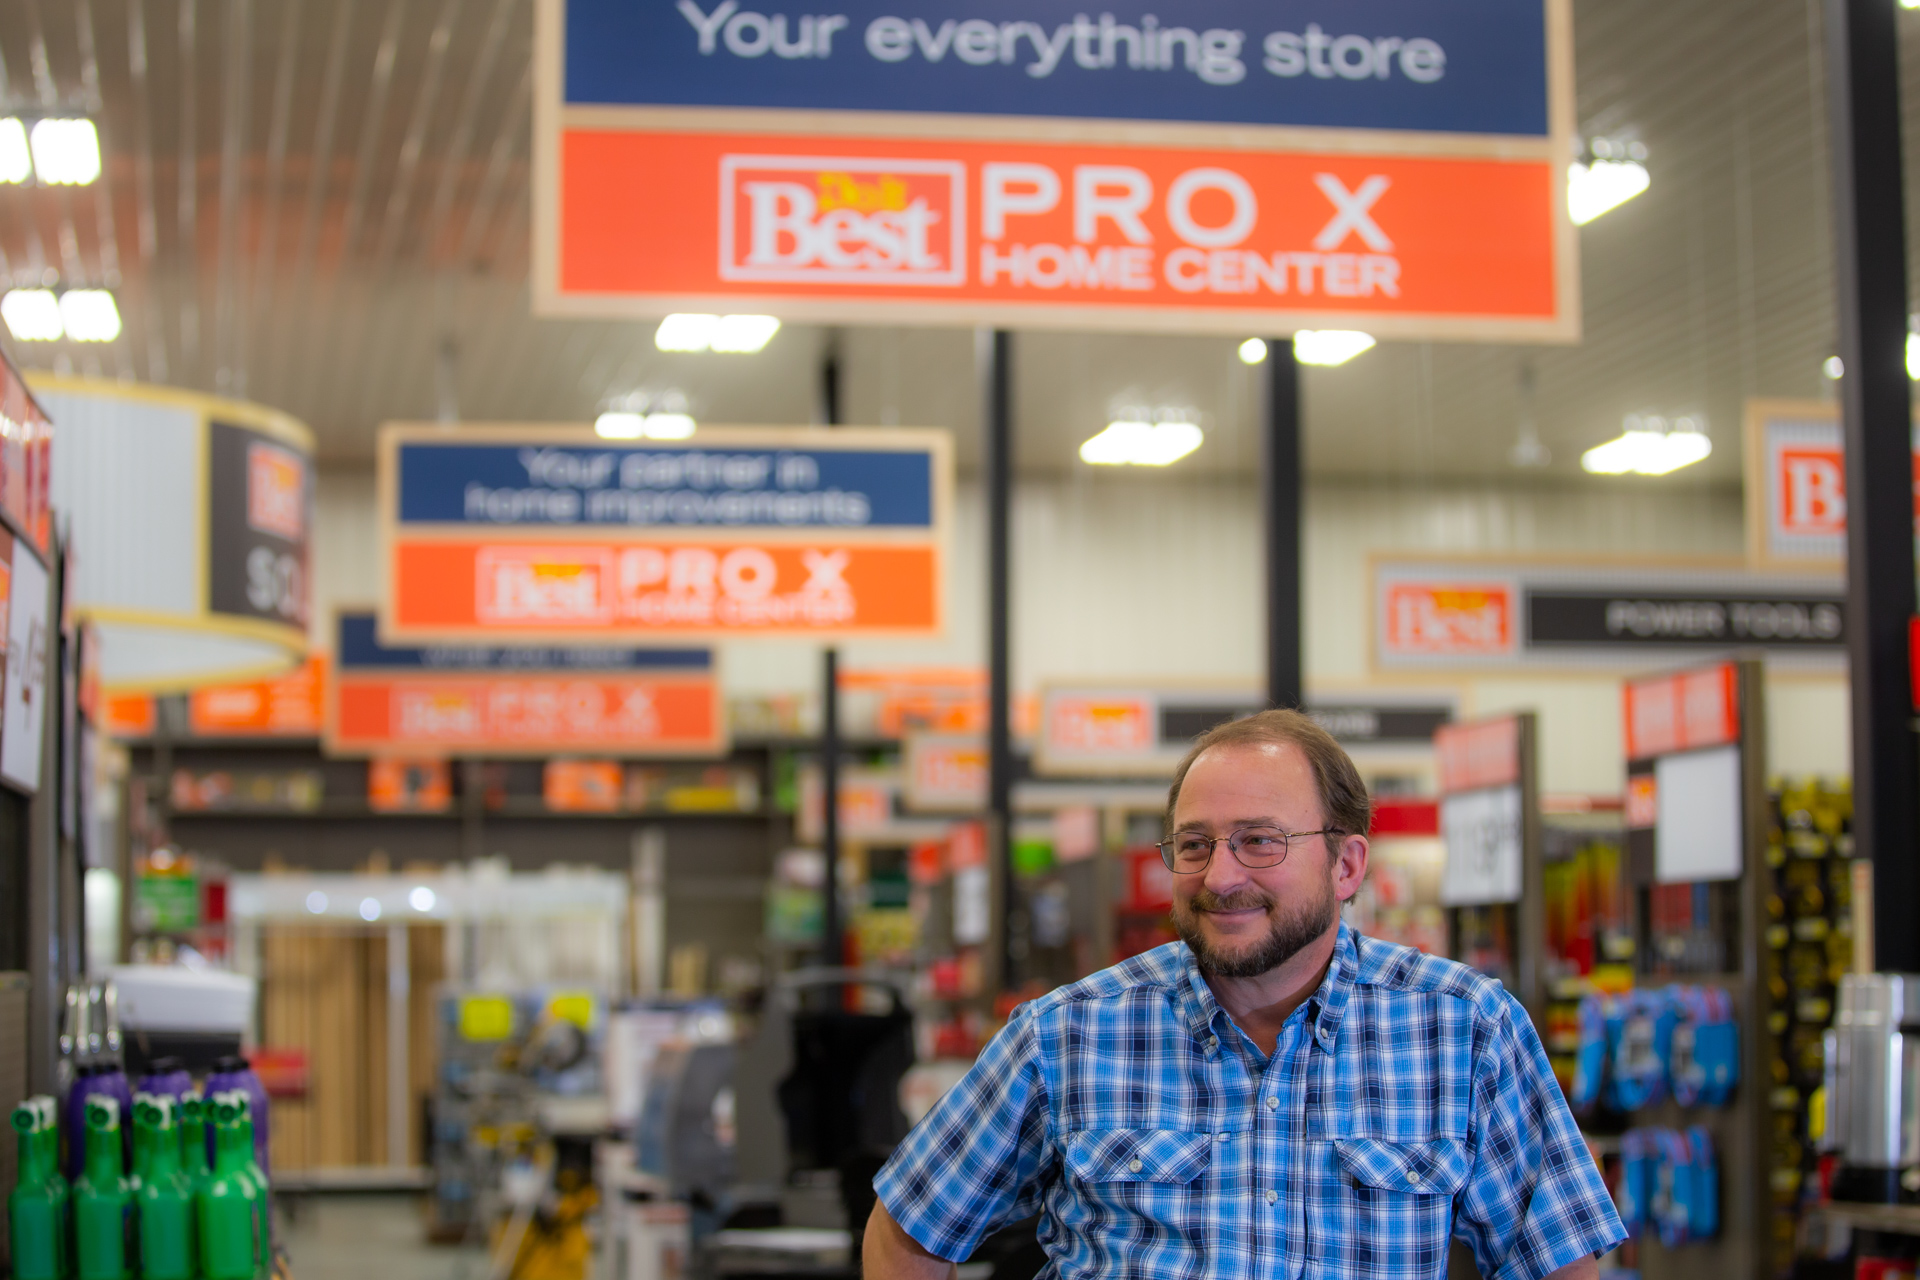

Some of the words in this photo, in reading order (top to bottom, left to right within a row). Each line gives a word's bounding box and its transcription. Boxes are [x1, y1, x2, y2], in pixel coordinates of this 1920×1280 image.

[676, 0, 848, 58] Your
[865, 11, 1247, 86] everything
[1263, 22, 1447, 83] store
[740, 181, 943, 270] Best
[981, 161, 1258, 249] PRO
[1312, 172, 1395, 252] X
[980, 242, 1156, 291] HOME
[1163, 247, 1402, 299] CENTER
[518, 446, 619, 489] Your
[619, 449, 772, 491] partner
[774, 450, 820, 490] in
[464, 481, 582, 524] home
[584, 486, 872, 527] improvements
[618, 547, 777, 600] PRO
[803, 549, 853, 597] X
[1605, 599, 1726, 639] POWER
[1728, 601, 1843, 639] TOOLS
